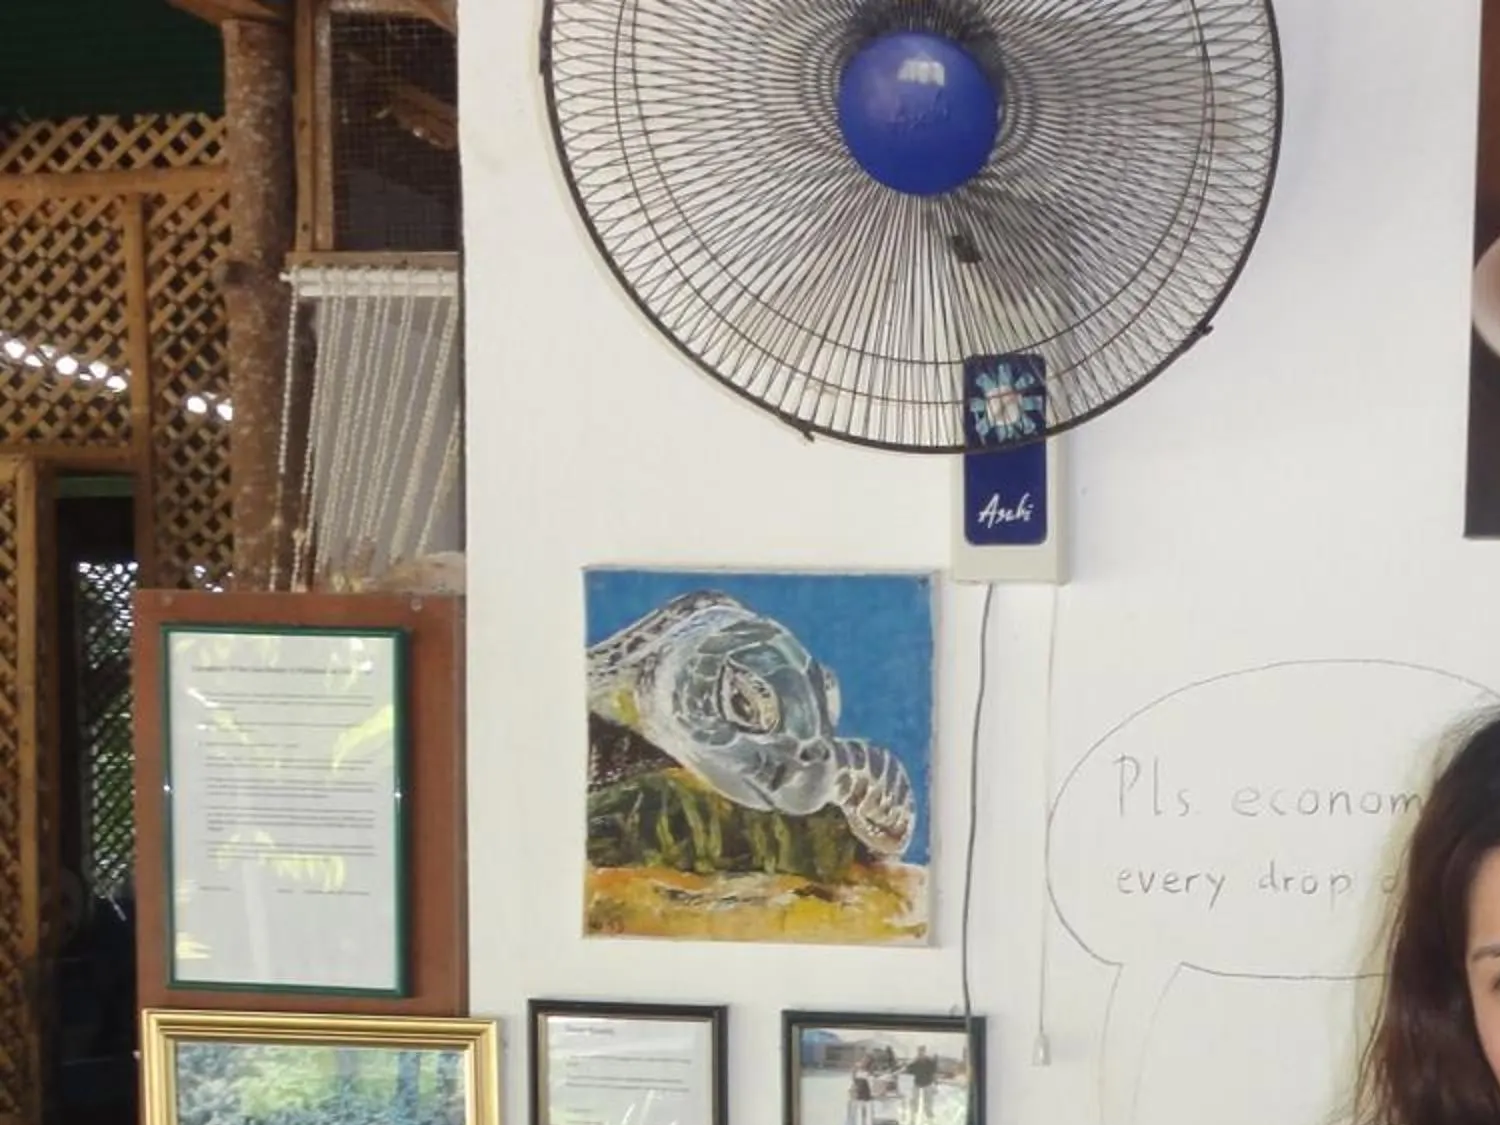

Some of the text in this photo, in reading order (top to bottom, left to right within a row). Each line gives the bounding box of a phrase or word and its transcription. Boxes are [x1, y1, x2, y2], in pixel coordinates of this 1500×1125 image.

[977, 493, 1034, 529] Asahi
[1112, 754, 1191, 818] Pls
[1116, 866, 1227, 911] every
[1258, 860, 1355, 911] drop
